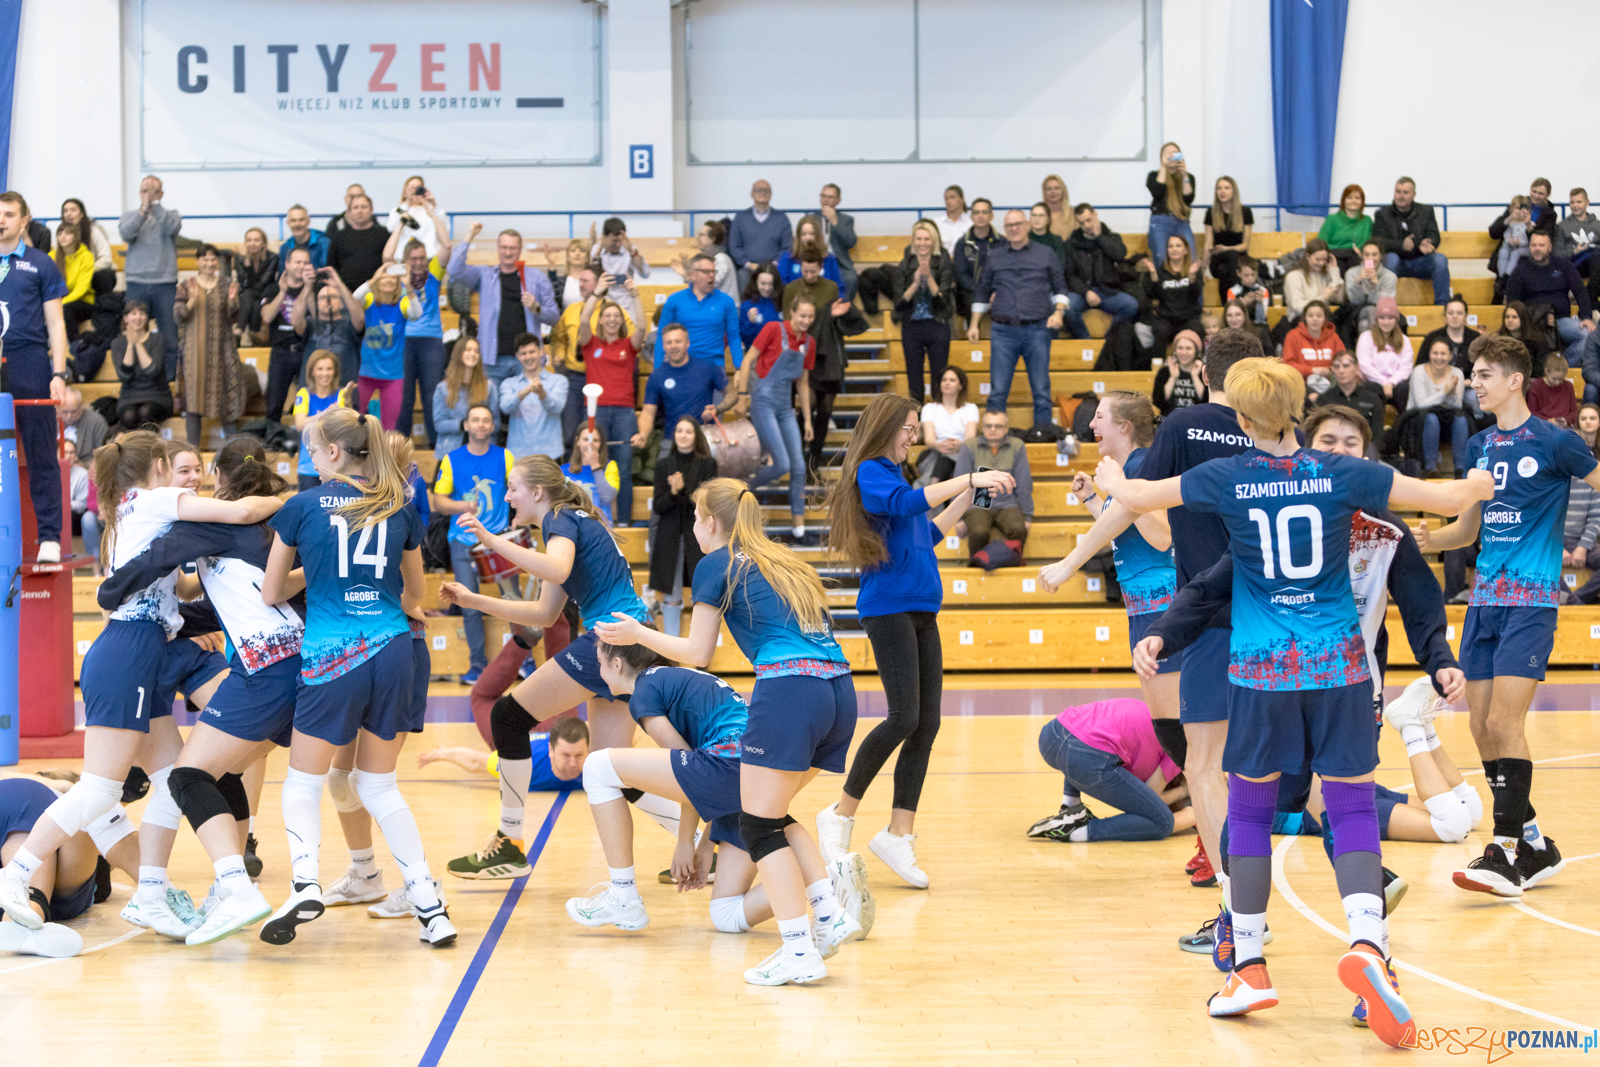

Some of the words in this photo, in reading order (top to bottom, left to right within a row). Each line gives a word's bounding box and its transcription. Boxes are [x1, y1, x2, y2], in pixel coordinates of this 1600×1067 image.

[177, 42, 501, 94] CITYZEN
[277, 98, 330, 112] WIĘCEJ
[372, 97, 411, 110] KLUB
[418, 96, 502, 110] SPORTOWY
[633, 149, 651, 174] B
[1235, 477, 1333, 500] SZAMOTULANIN
[1492, 461, 1509, 490] 9
[1483, 510, 1523, 525] AGROBEX
[330, 514, 388, 580] 14
[1248, 504, 1324, 580] 10
[344, 590, 380, 602] AGROBEX
[135, 686, 145, 719] 1
